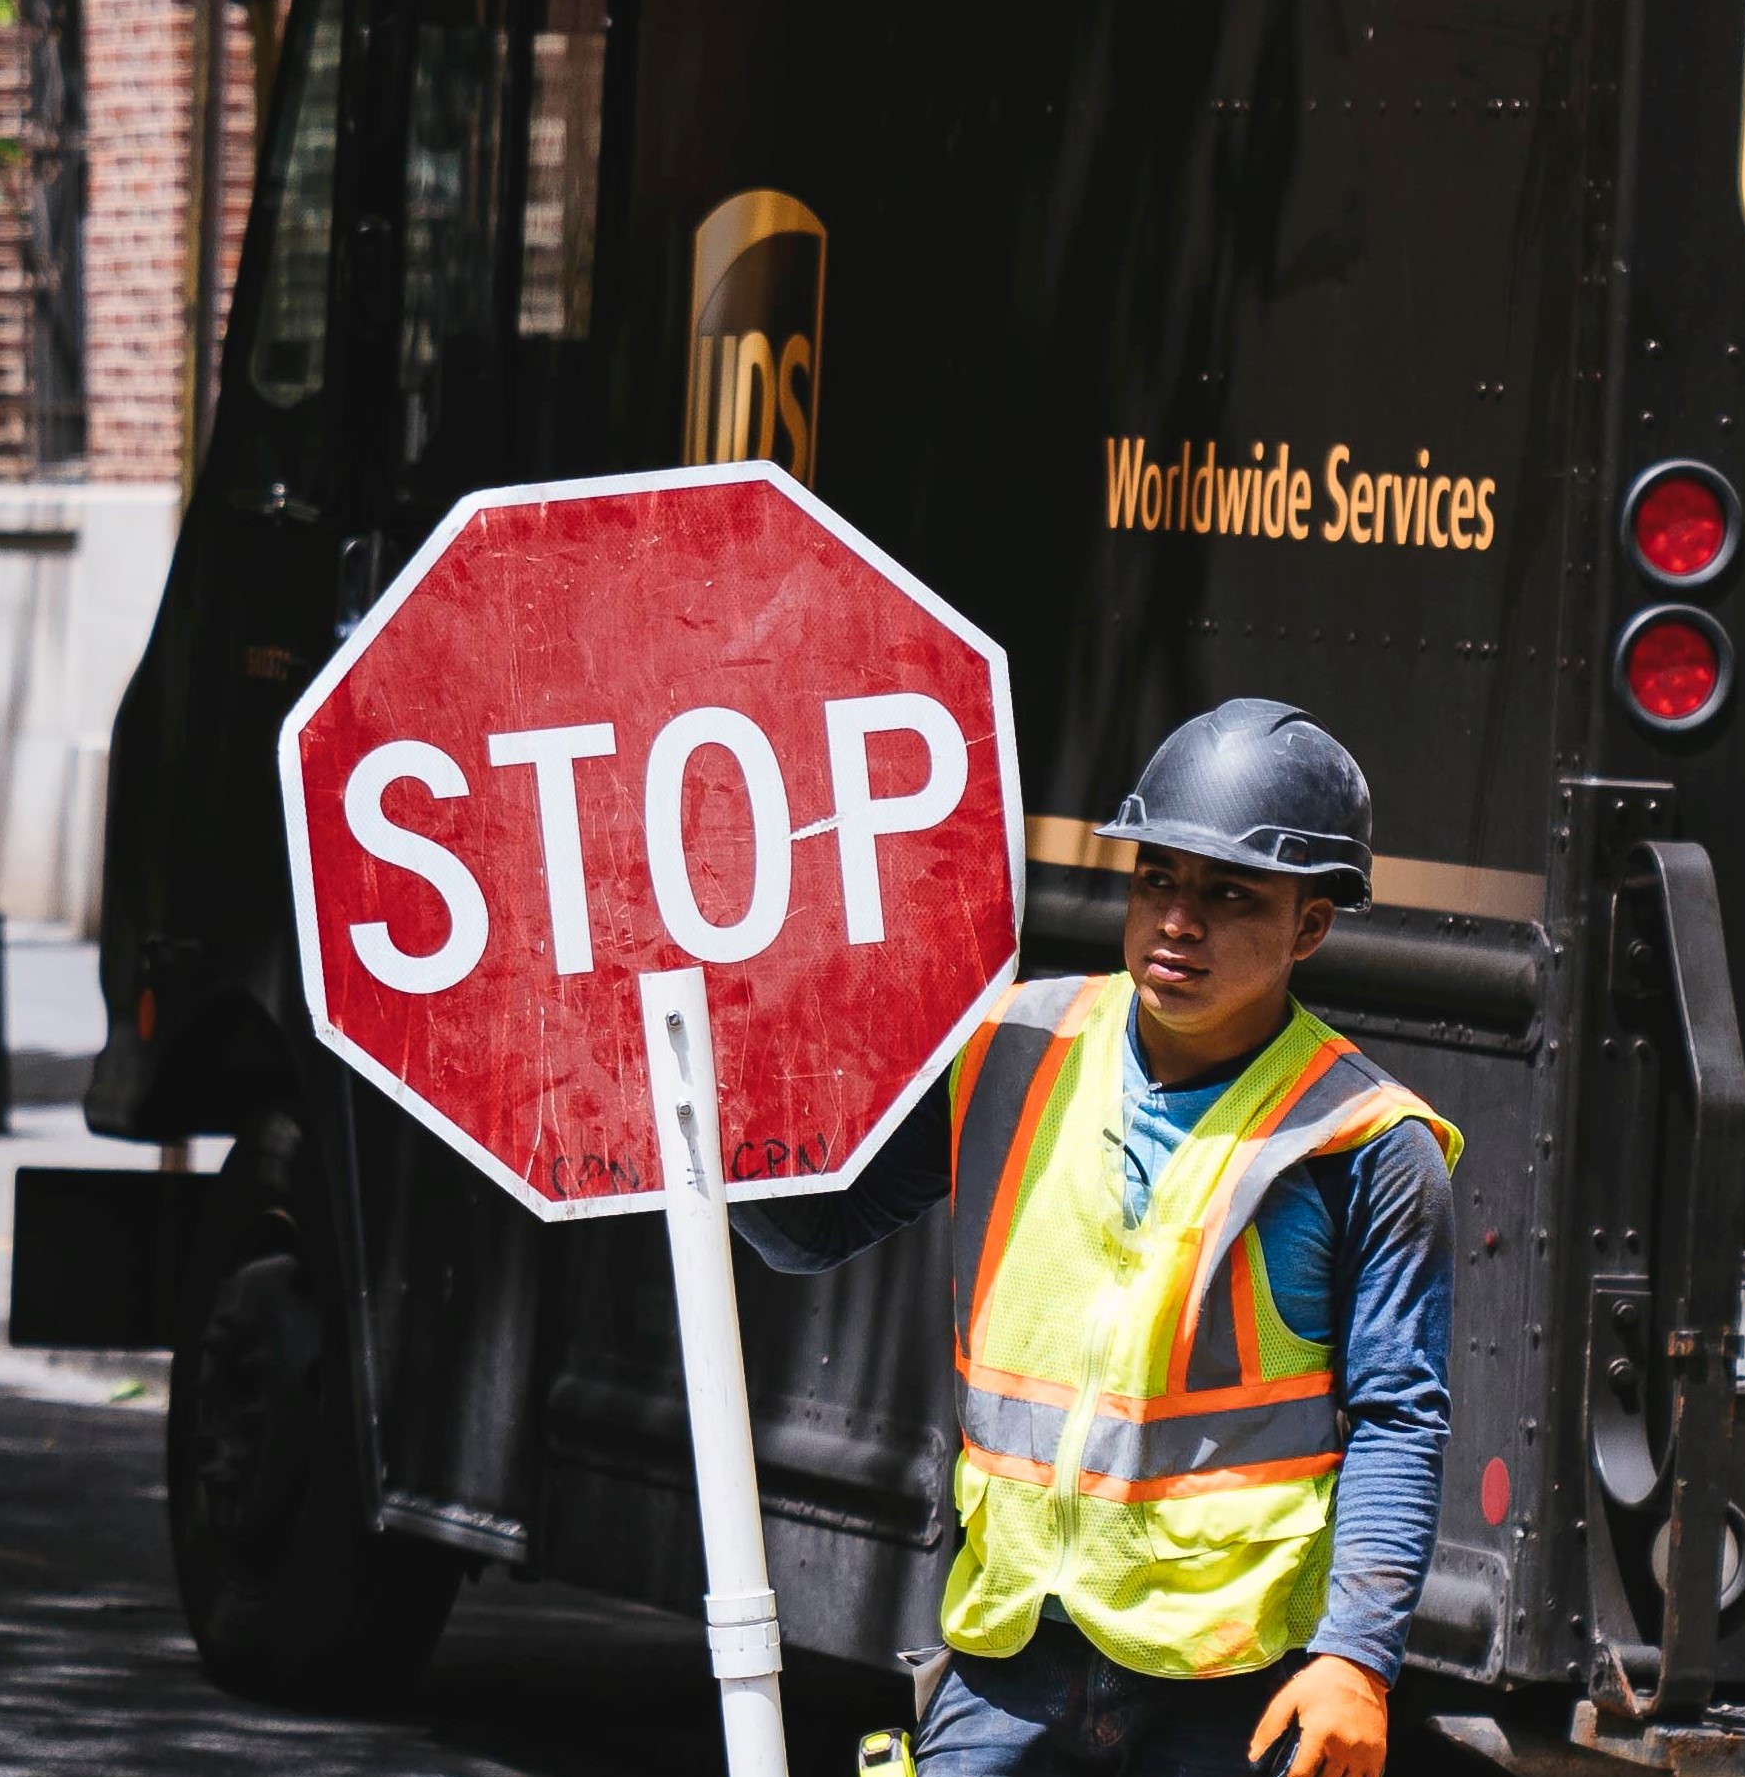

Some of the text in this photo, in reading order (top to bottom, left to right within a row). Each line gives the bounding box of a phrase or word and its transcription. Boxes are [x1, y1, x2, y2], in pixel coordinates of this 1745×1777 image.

[1106, 436, 1496, 551] Worldwide Services
[344, 692, 968, 994] STOP
